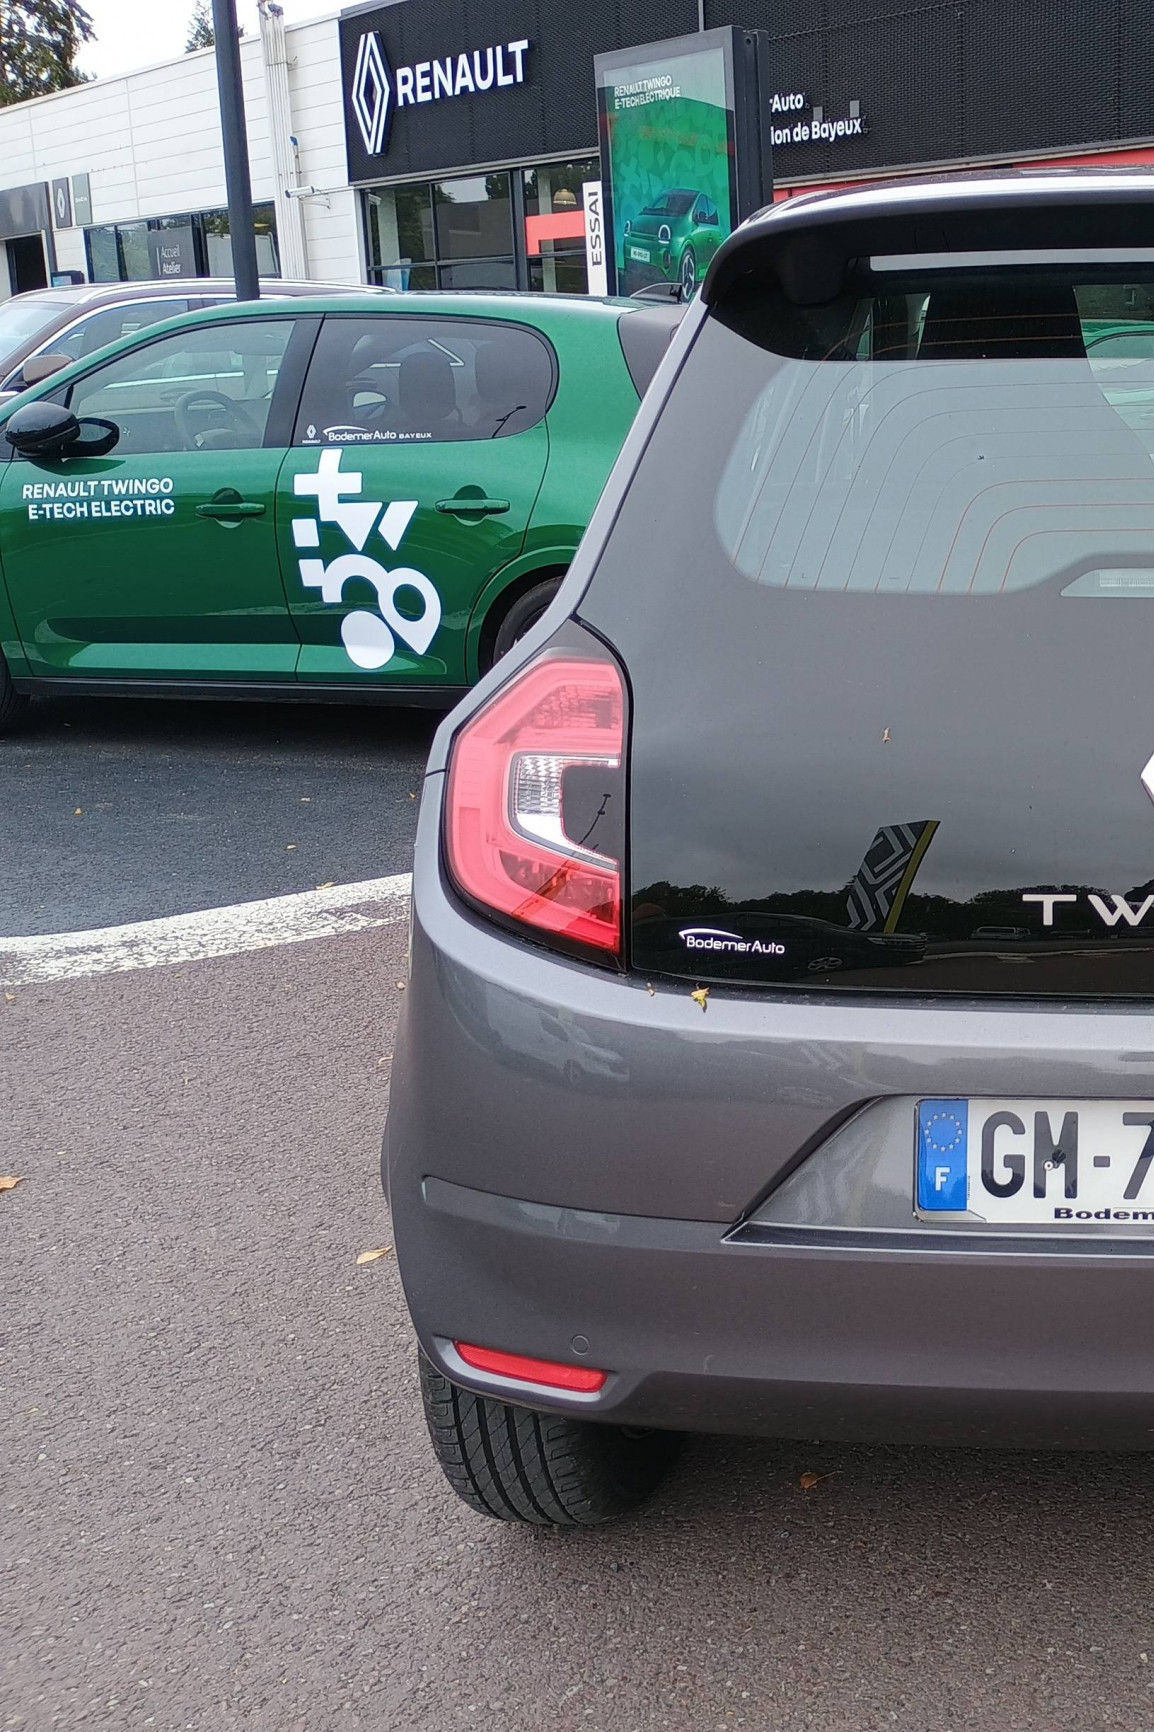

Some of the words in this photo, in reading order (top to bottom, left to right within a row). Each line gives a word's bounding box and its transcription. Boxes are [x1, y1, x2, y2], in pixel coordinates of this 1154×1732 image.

[396, 39, 529, 106] RENAULT
[614, 81, 643, 97] RENAULT
[643, 75, 672, 91] TWINGO
[614, 96, 640, 109] E-TECH
[640, 86, 681, 105] ELECTRIQUE
[769, 92, 804, 113] Auto
[793, 121, 810, 142] de
[811, 118, 862, 142] Bayeux
[588, 191, 603, 267] ESSAI
[161, 245, 180, 258] Accueil
[162, 261, 181, 274] Atelier
[328, 430, 397, 442] BodemerAuto
[22, 481, 99, 499] RENAULT
[100, 478, 174, 496] TWINGO
[28, 502, 88, 520] E-TECH
[91, 499, 175, 517] ELECTRIC
[686, 935, 786, 954] BodemerAuto
[935, 1166, 951, 1191] F
